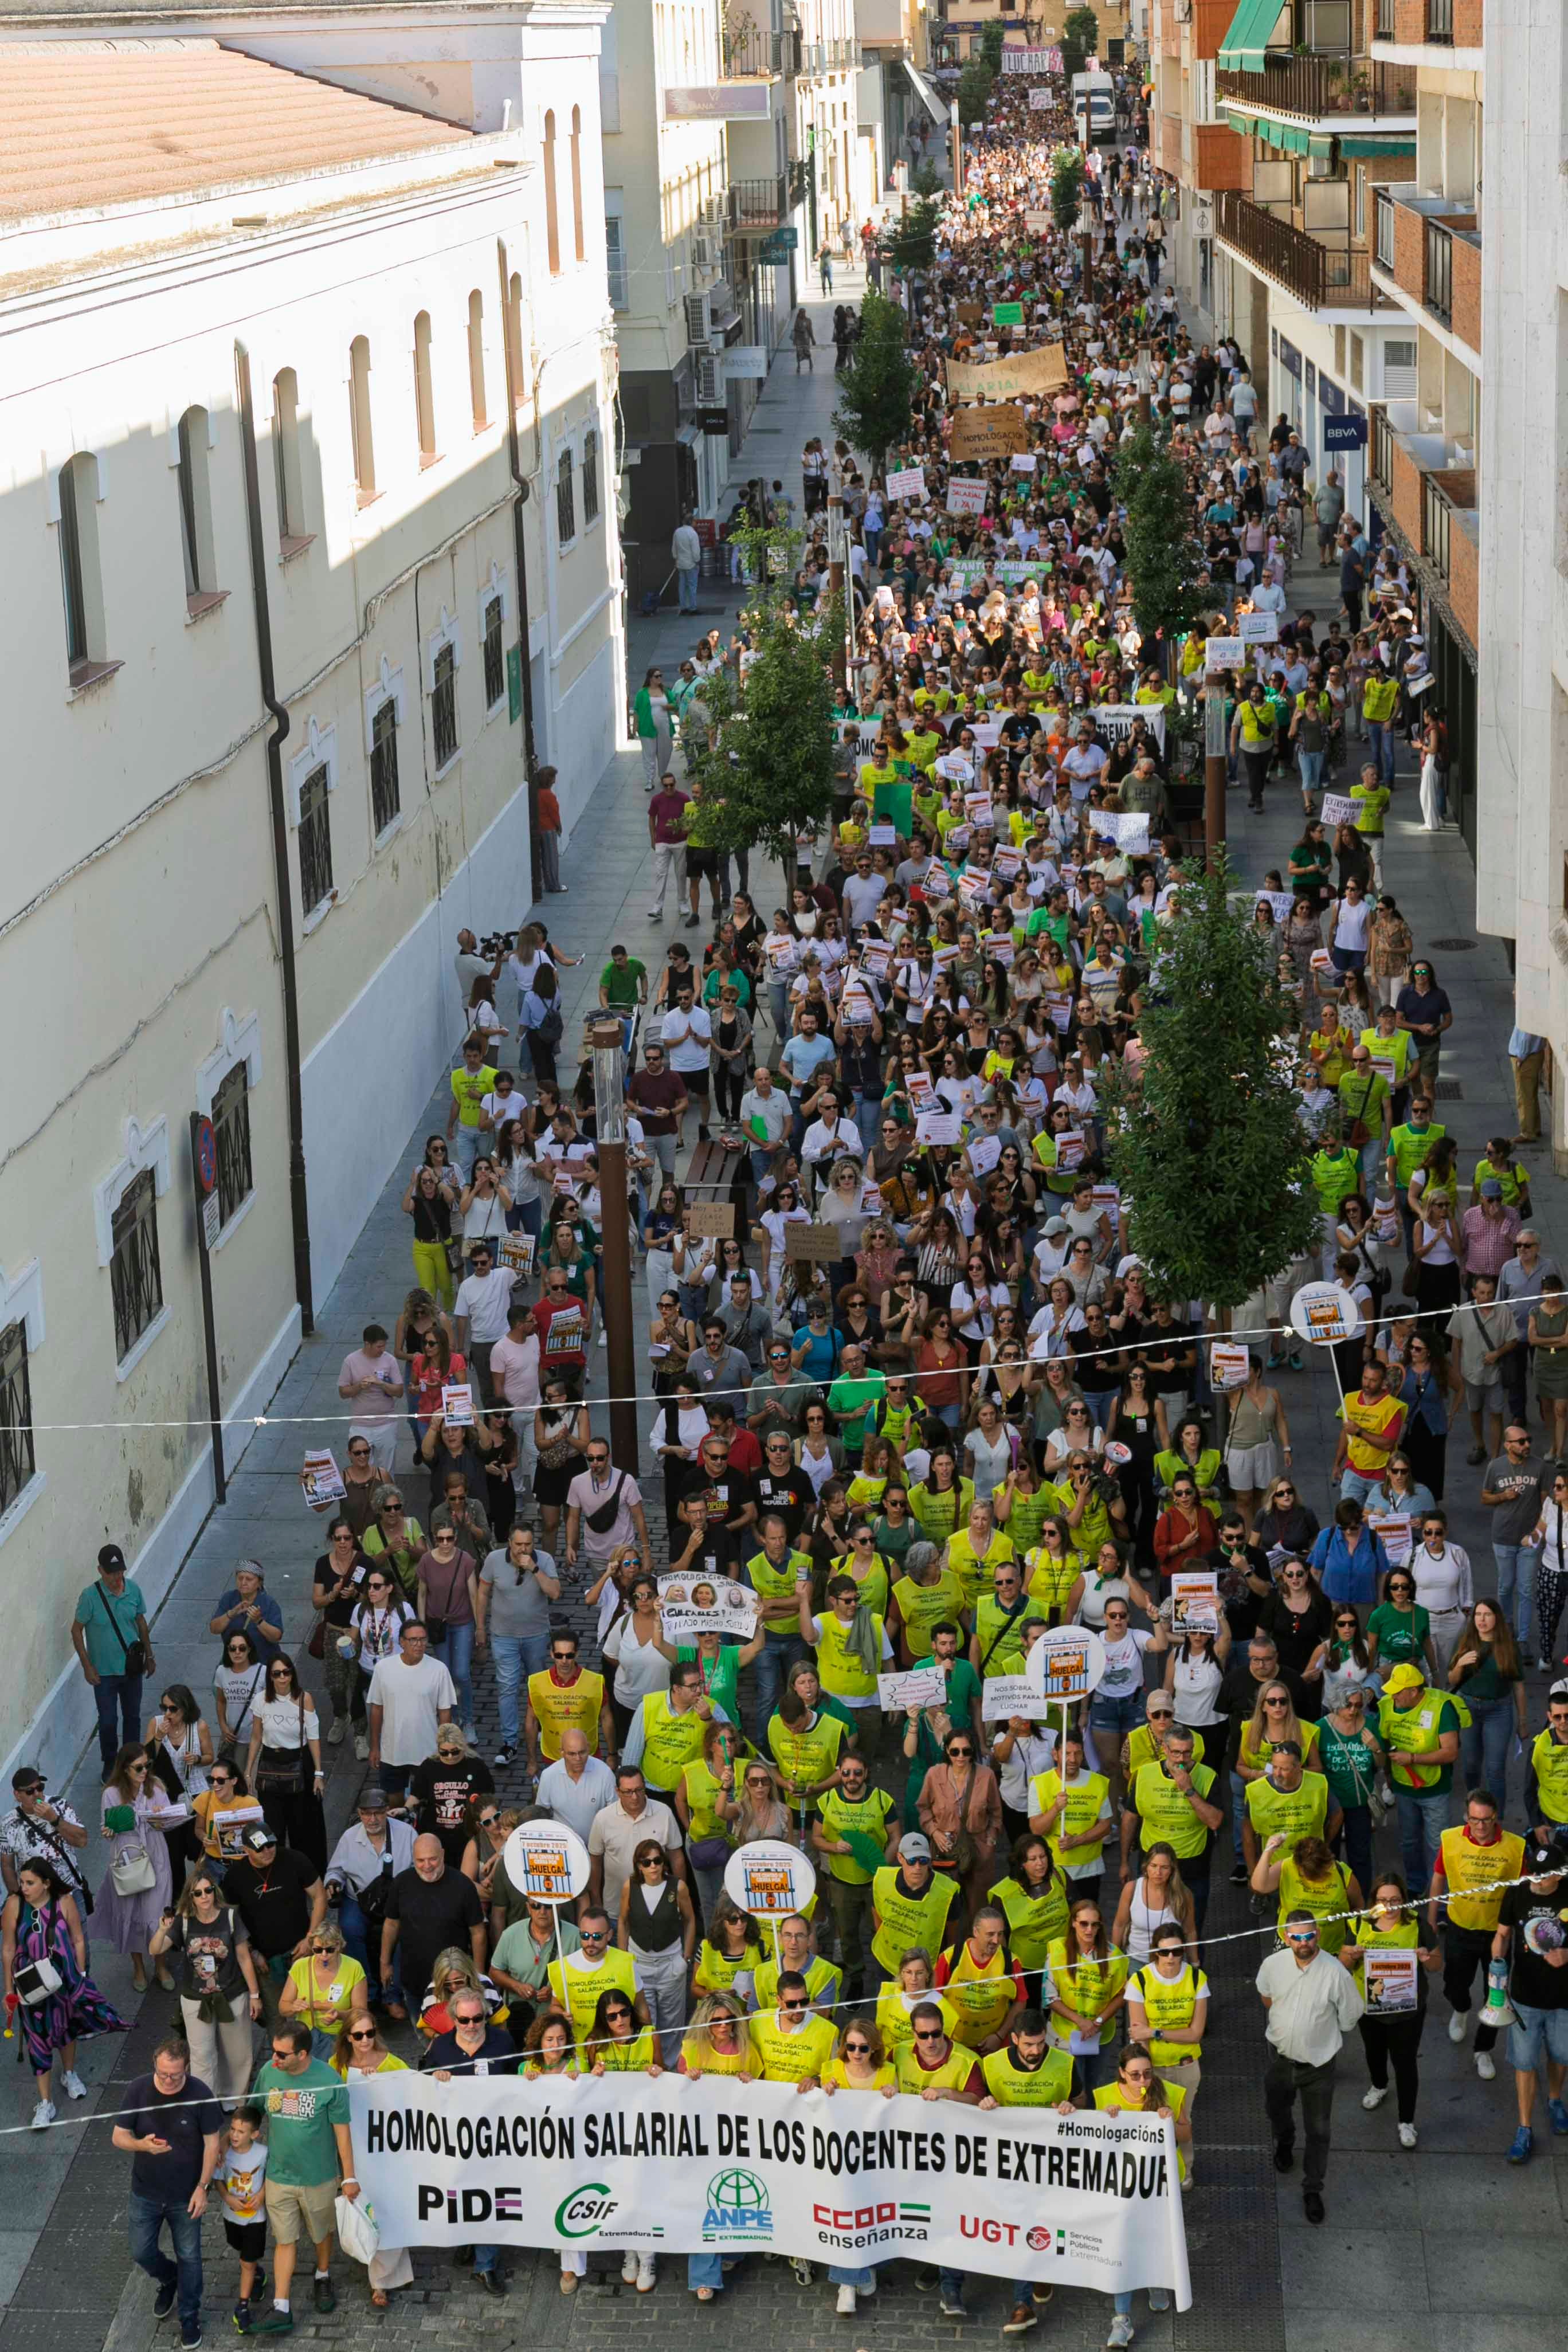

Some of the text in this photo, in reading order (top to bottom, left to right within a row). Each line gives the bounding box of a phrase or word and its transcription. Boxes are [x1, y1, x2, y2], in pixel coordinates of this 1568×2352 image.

[1327, 428, 1357, 438] BBVA
[1497, 1475, 1537, 1487] SILBON
[530, 1865, 564, 1874] ¡HUELGA!
[578, 1986, 606, 1994] SALARIAL
[368, 2106, 575, 2159] HOMOLOGACIÓN
[585, 2112, 709, 2158] SALARIAL
[718, 2114, 750, 2158] DE
[760, 2119, 805, 2165] LOS
[813, 2126, 946, 2176] DOCENTES
[955, 2134, 987, 2177] DE
[1057, 2122, 1164, 2144] #HomologaciónS
[567, 2201, 618, 2220] CSIF
[703, 2208, 773, 2228] ANPE
[814, 2203, 896, 2230] CCOO
[599, 2230, 651, 2238] Extremadura
[818, 2225, 927, 2249] enseñanza
[960, 2214, 1020, 2247] UGT
[1070, 2231, 1103, 2244] Servicios
[1070, 2241, 1100, 2252] Públicos
[1070, 2249, 1122, 2268] Extremadura
